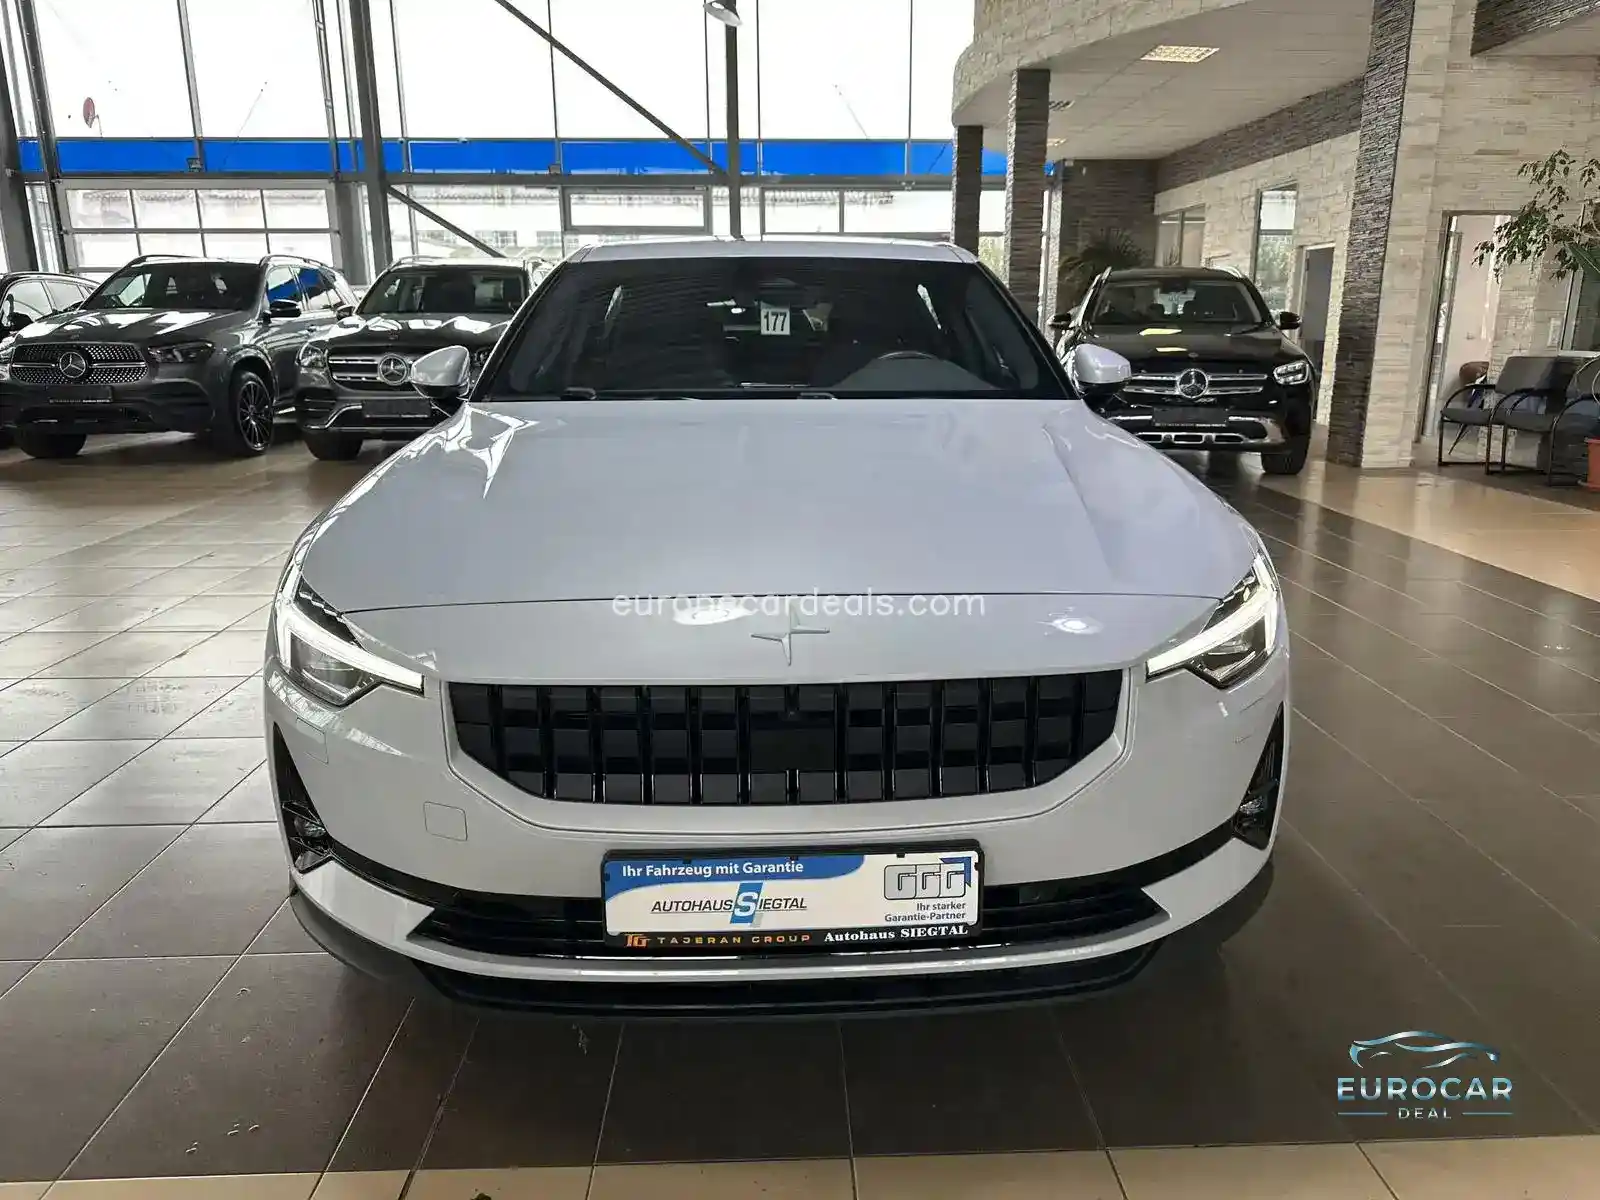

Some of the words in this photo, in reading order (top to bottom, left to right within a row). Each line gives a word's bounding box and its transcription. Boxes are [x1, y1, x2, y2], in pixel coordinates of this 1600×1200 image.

[763, 311, 788, 332] 177
[622, 865, 643, 877] Ihr
[646, 864, 712, 878] Fahrzeug
[715, 863, 739, 875] mit
[742, 861, 804, 874] Garantie
[651, 899, 734, 912] AUTOHAUS
[916, 902, 930, 912] Ihr
[932, 901, 966, 911] starker
[884, 911, 966, 922] Garantie-Partner
[657, 936, 742, 945] TAJERAN
[751, 935, 811, 944] GROUP
[824, 930, 896, 943] Autohaus
[900, 925, 969, 938] SIEGTAL
